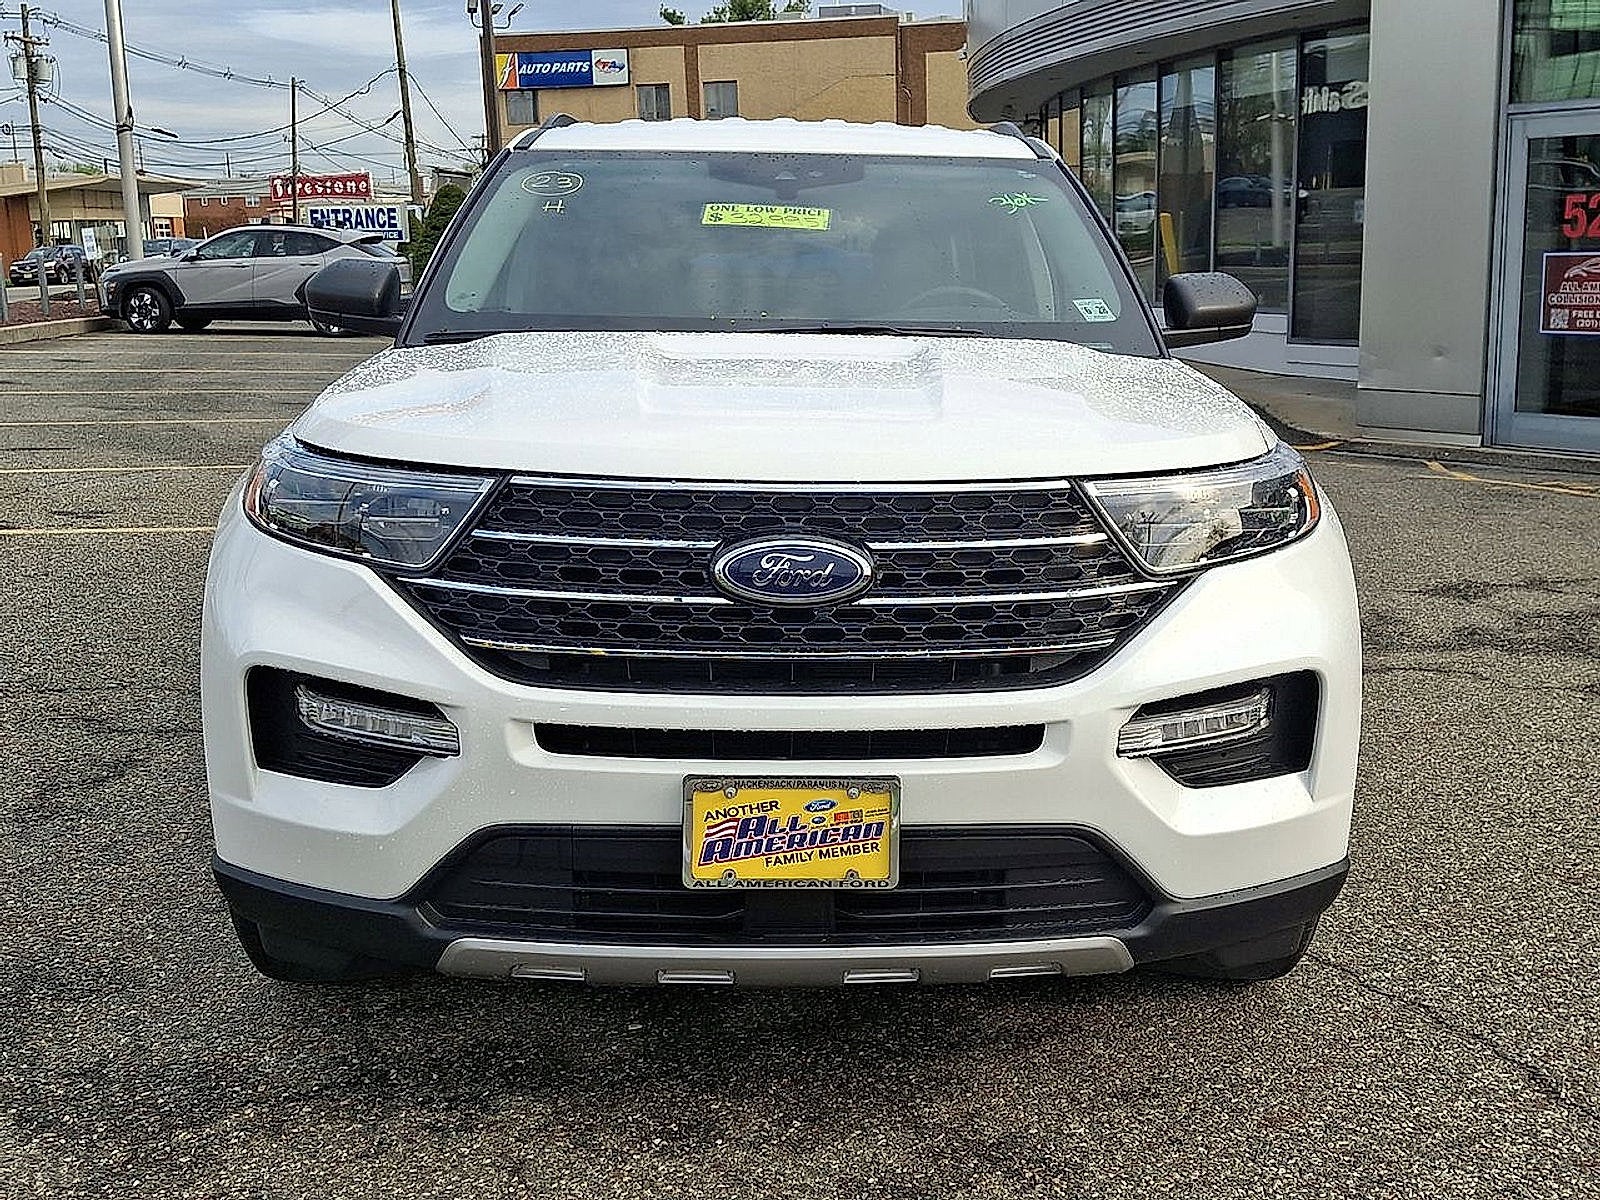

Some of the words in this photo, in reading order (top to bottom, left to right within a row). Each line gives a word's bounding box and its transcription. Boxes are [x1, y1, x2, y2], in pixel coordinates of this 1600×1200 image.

[519, 63, 551, 75] AUTO
[552, 61, 591, 73] PARTS
[273, 179, 368, 198] Firestone
[531, 175, 573, 188] 23
[309, 207, 398, 229] ENTRANCE
[709, 204, 741, 212] ONE
[746, 206, 778, 214] LOW
[783, 207, 825, 217] PRICE
[1560, 281, 1580, 293] ALL
[1582, 281, 1600, 293] AM
[1572, 310, 1595, 318] FREE
[752, 553, 836, 587] Ford
[704, 800, 780, 822] ANOTHER
[809, 801, 833, 812] Ford
[737, 815, 808, 840] ALL
[701, 821, 885, 862] AMERICAN
[764, 850, 815, 867] FAMILY
[818, 841, 880, 860] MEMBER
[693, 880, 728, 889] ALL
[732, 880, 833, 889] AMERICAN
[839, 880, 890, 889] FORD
